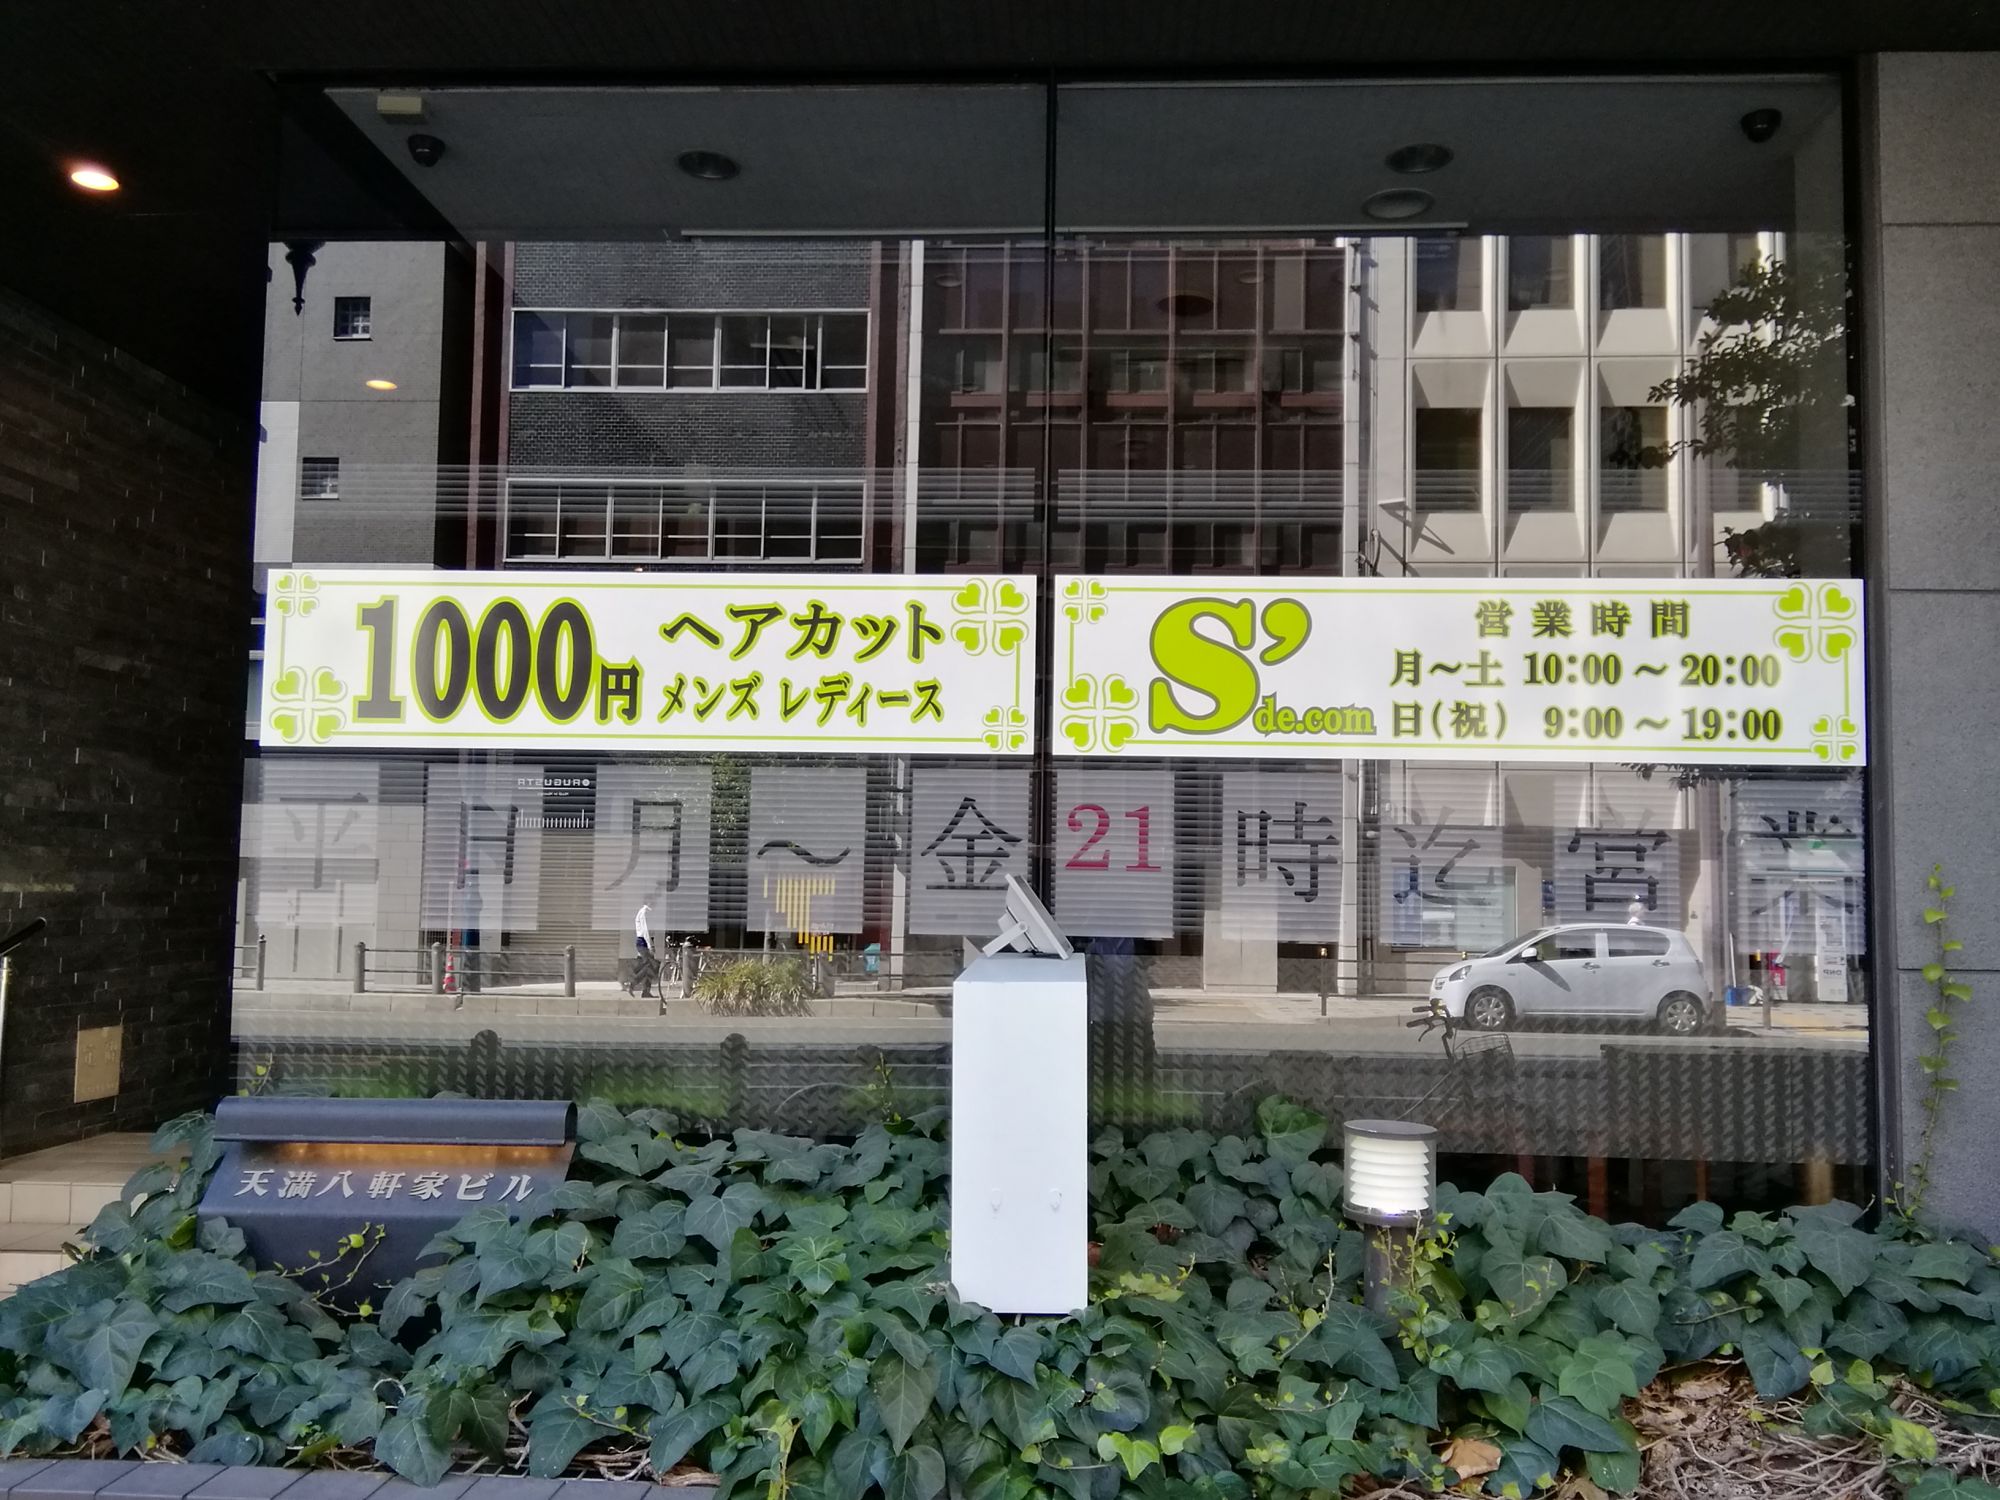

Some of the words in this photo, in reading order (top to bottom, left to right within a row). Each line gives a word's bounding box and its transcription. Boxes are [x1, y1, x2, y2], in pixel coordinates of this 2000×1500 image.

[660, 600, 945, 663] ヘアカット
[1474, 599, 1691, 638] 営業時間
[353, 595, 644, 725] 1000円
[1522, 653, 1623, 687] 10:00
[1680, 653, 1782, 687] 20:00
[658, 671, 763, 723] メンズ
[779, 672, 945, 727] レディース
[1252, 692, 1377, 737] de.com
[1543, 705, 1625, 739] 9:00
[1682, 706, 1784, 741] 19:00
[234, 1168, 535, 1202] 天満八軒家ビル
